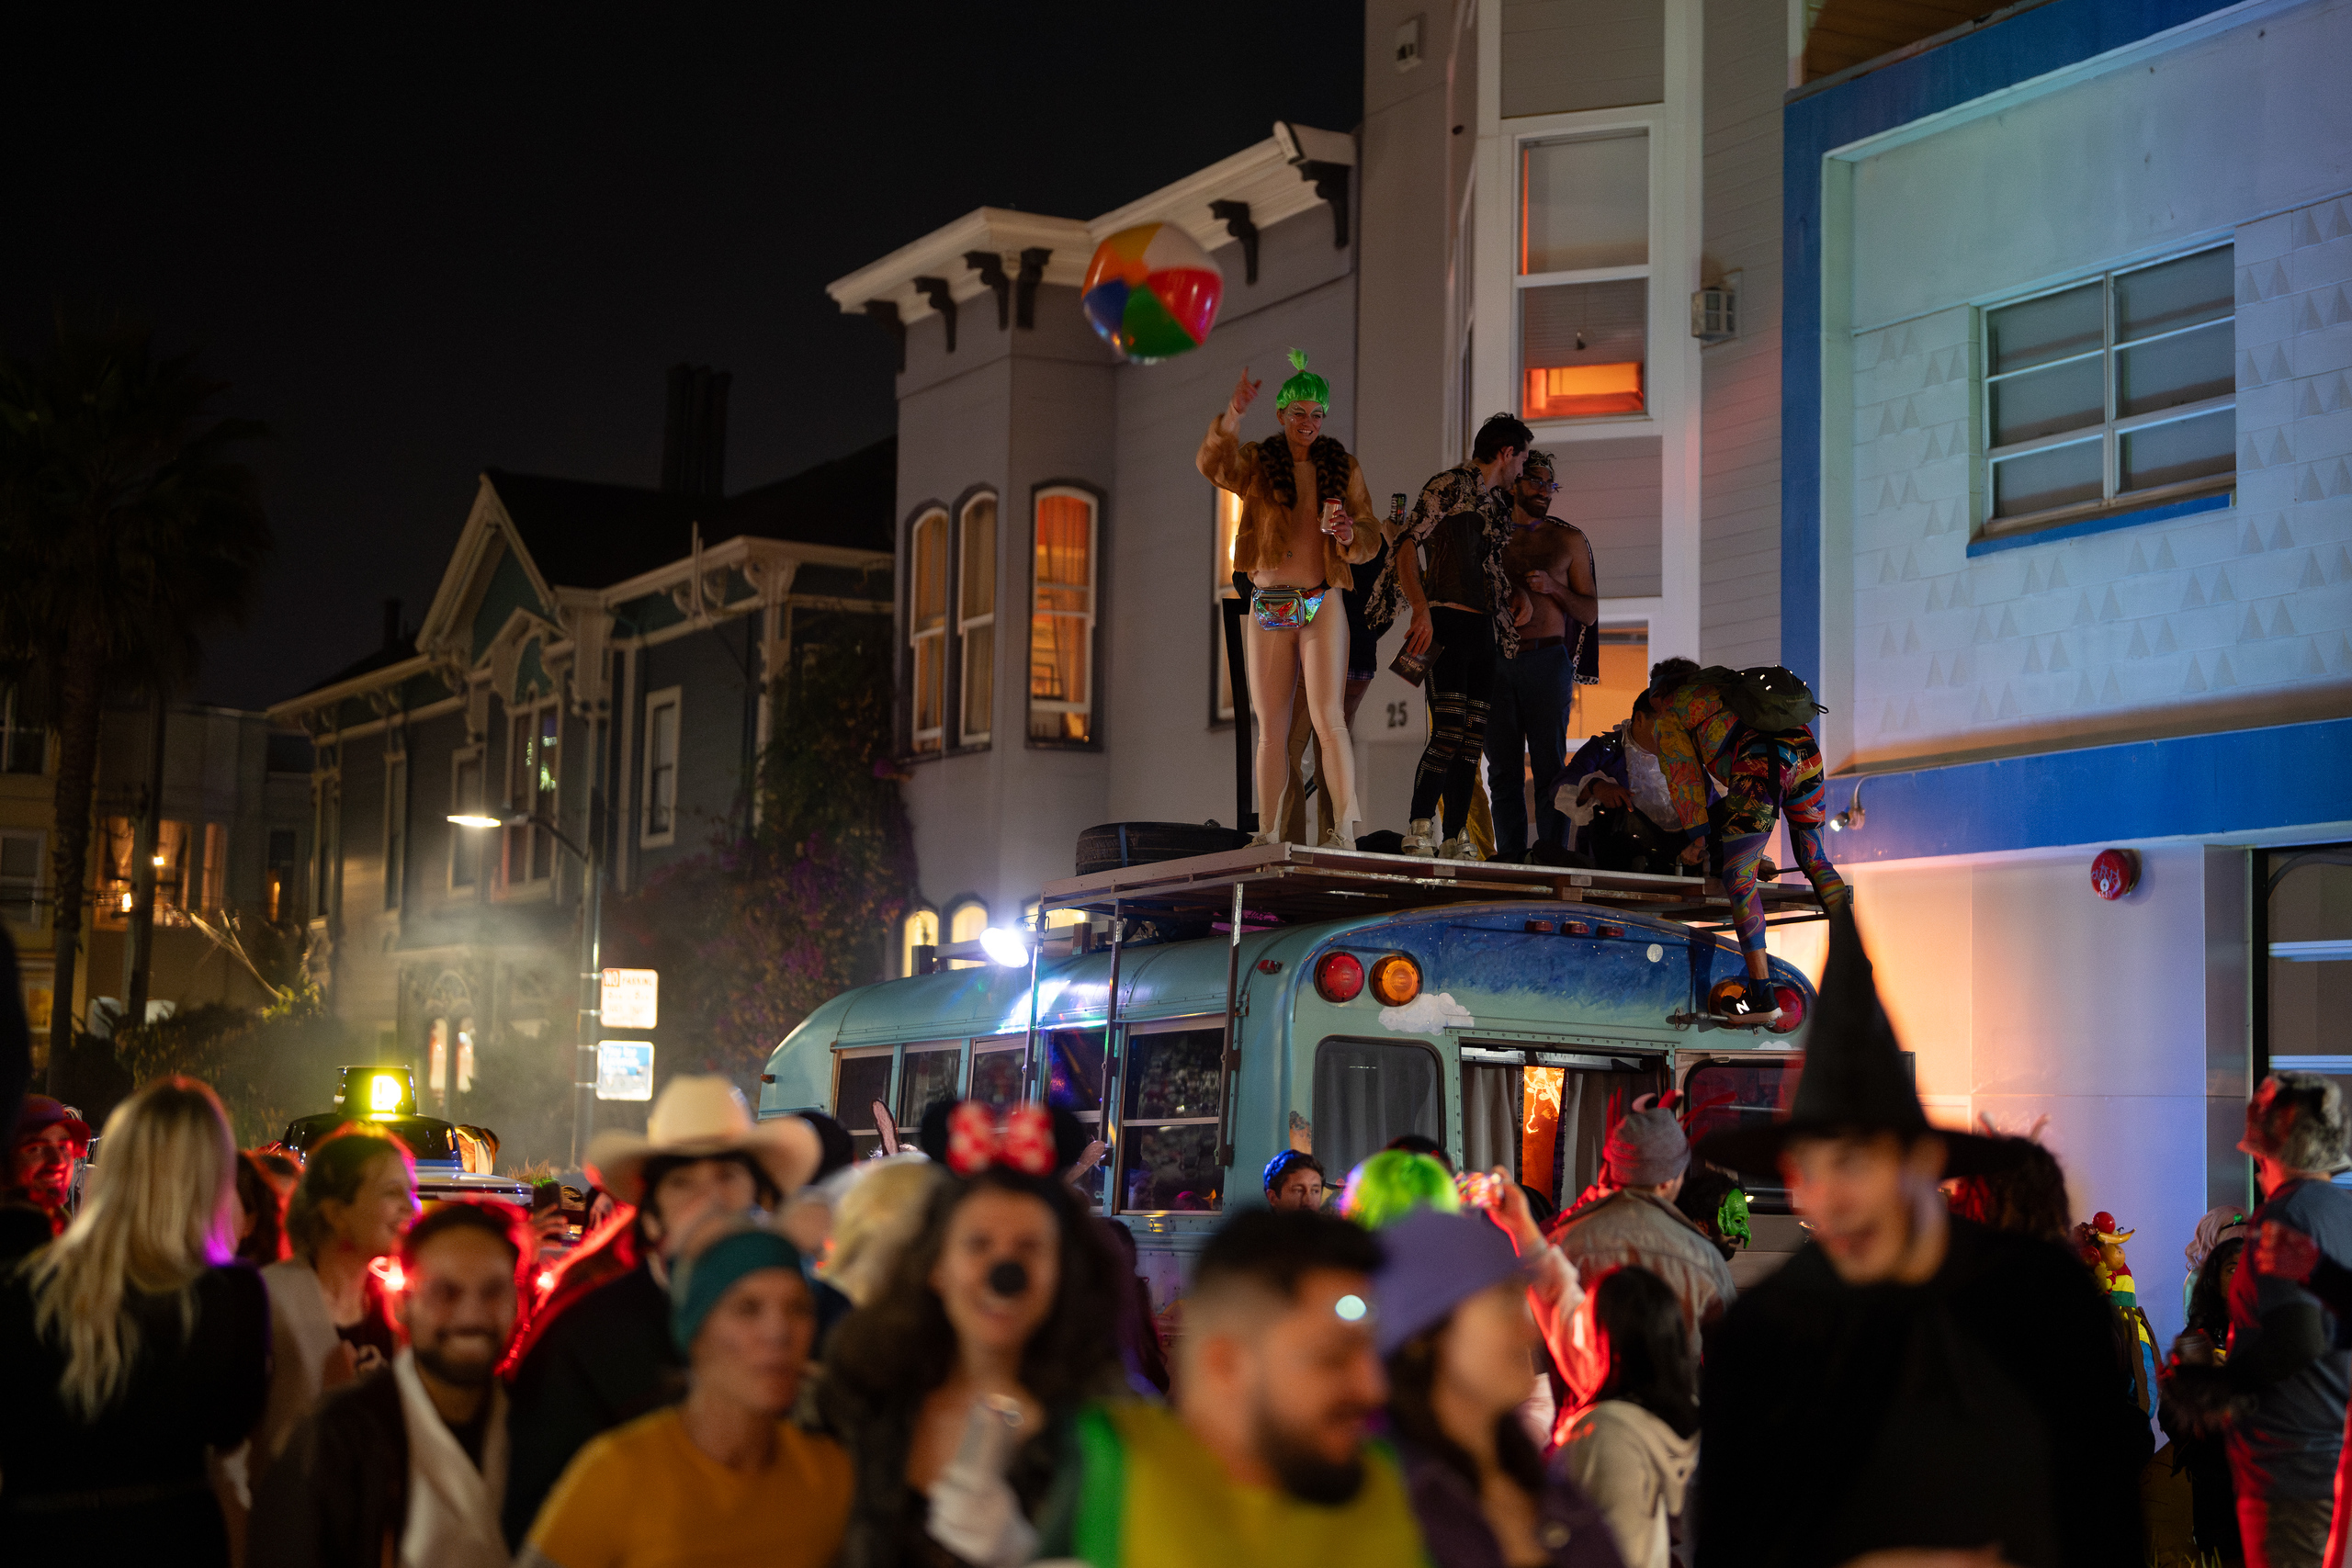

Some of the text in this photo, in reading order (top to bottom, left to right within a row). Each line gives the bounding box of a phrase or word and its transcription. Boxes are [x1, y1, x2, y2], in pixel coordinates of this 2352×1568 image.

[1386, 701, 1408, 728] 25
[605, 971, 619, 986] NO
[1736, 999, 1750, 1015] N
